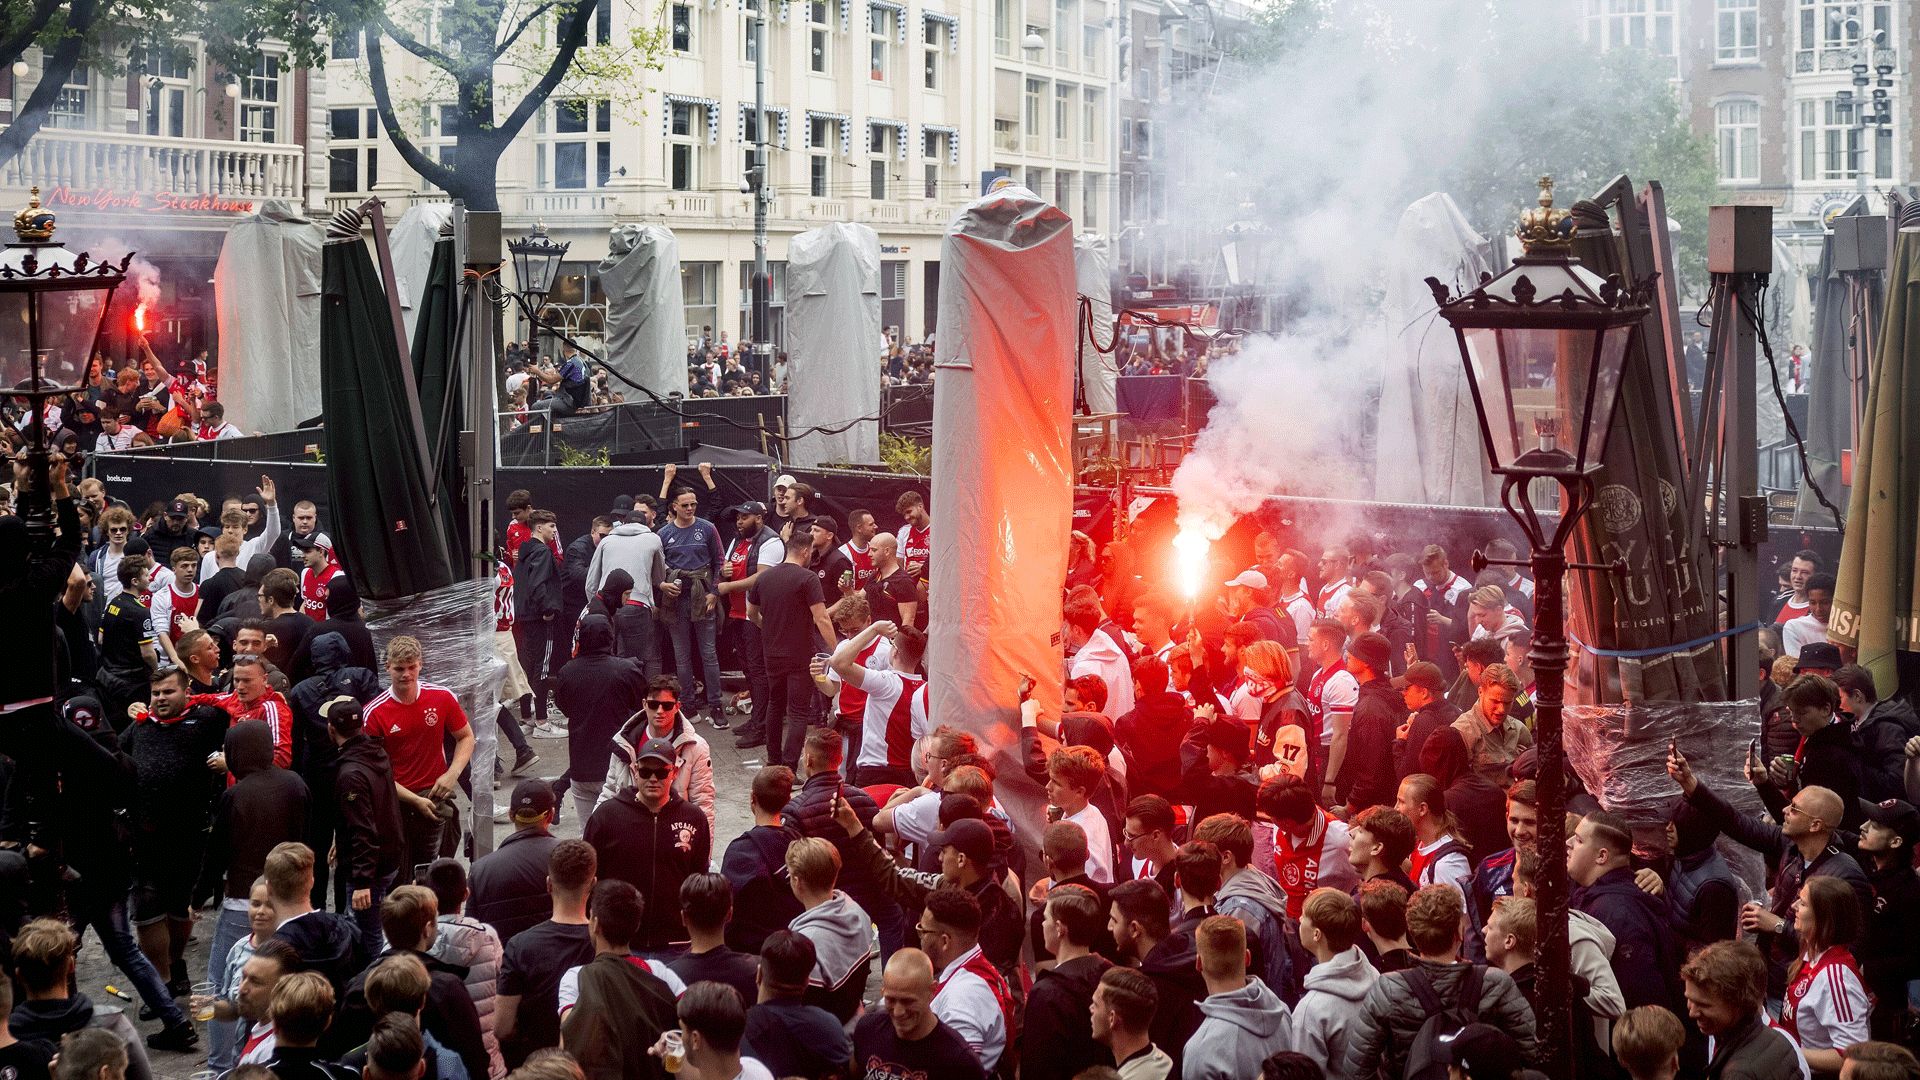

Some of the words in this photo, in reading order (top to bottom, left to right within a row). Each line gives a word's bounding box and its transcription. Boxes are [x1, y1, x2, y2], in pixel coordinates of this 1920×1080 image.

[46, 187, 90, 207] New
[92, 189, 141, 209] York
[147, 191, 254, 212] Steakhouse
[106, 474, 132, 483] boels.com
[1282, 744, 1301, 762] 17
